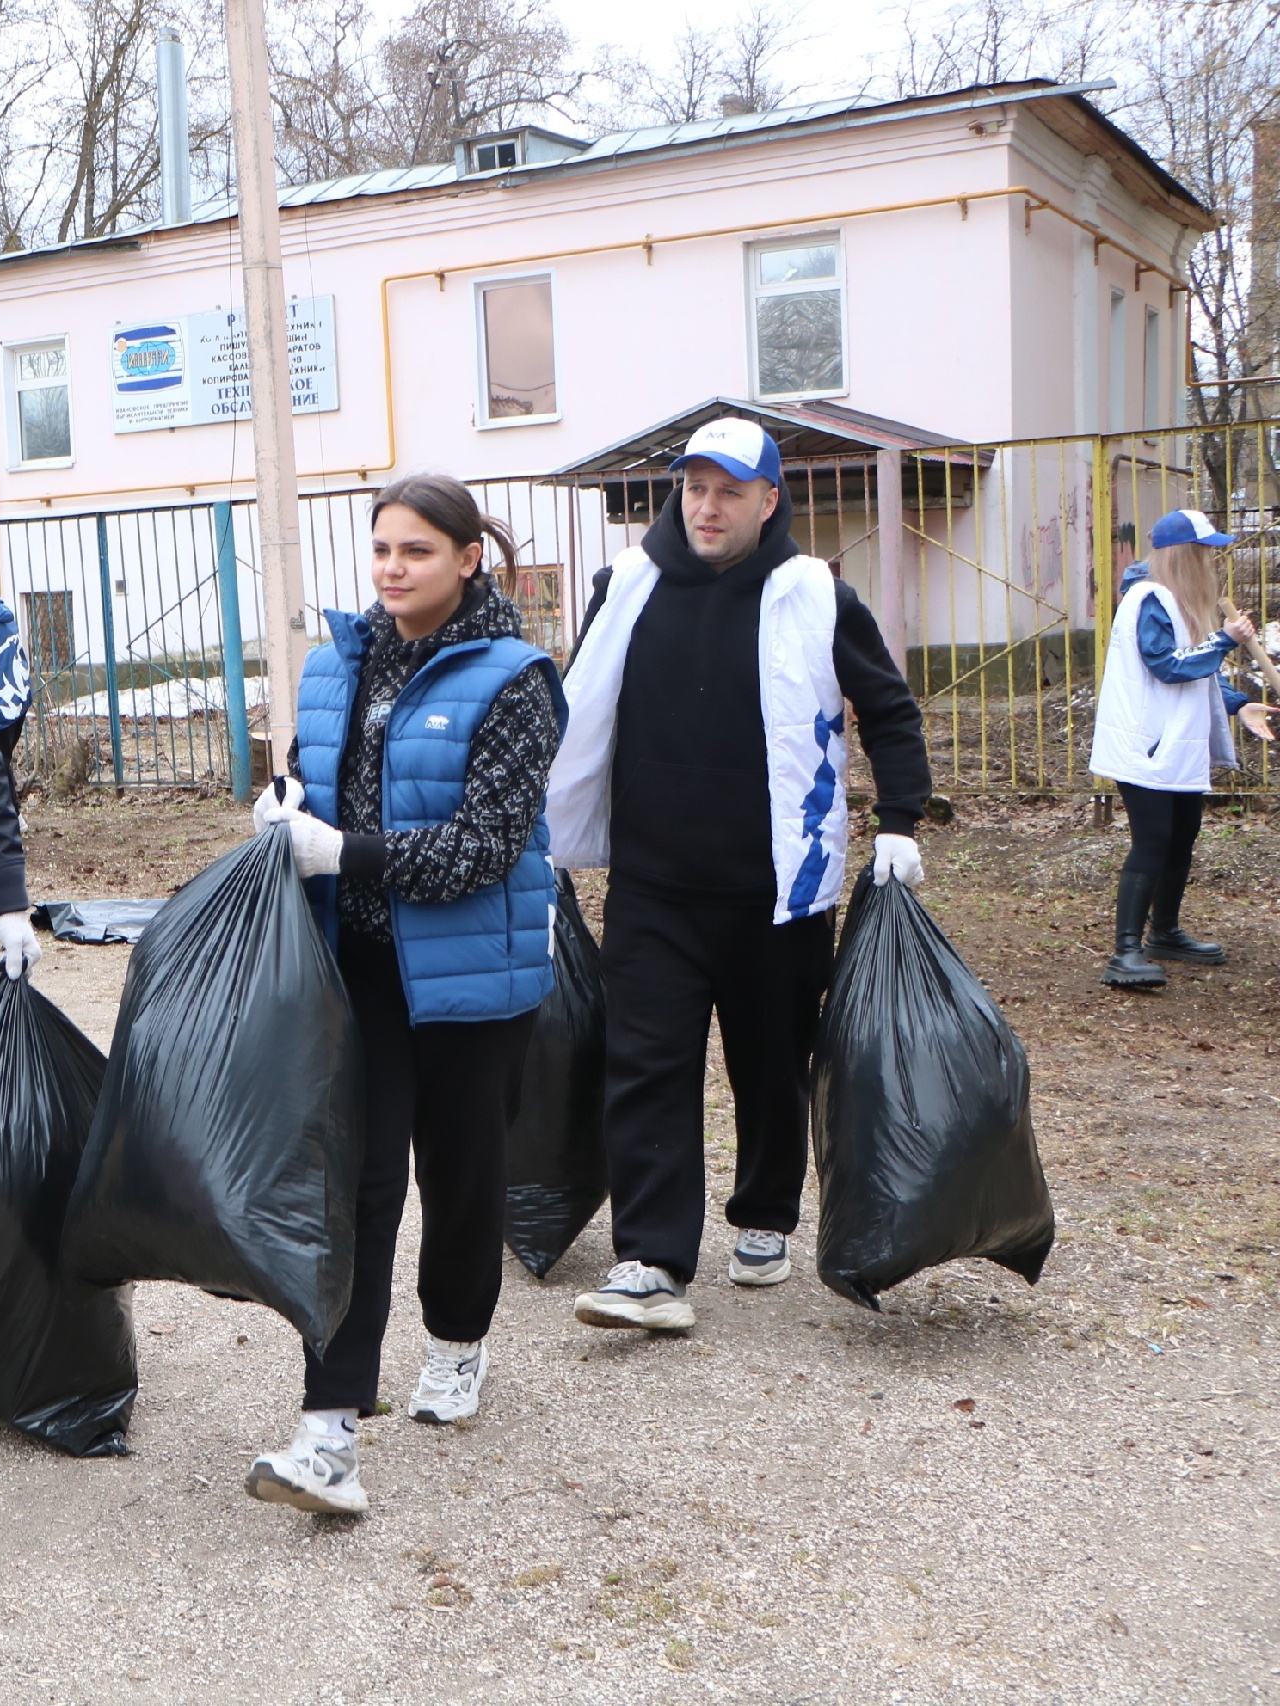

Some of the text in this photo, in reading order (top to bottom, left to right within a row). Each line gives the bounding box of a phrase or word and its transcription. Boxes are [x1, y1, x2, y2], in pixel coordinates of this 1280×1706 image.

[220, 334, 308, 352] ПИШУ ШИН
[211, 343, 321, 363] КАССОВ АРАТОВ
[202, 374, 250, 385] КОПИРОВА
